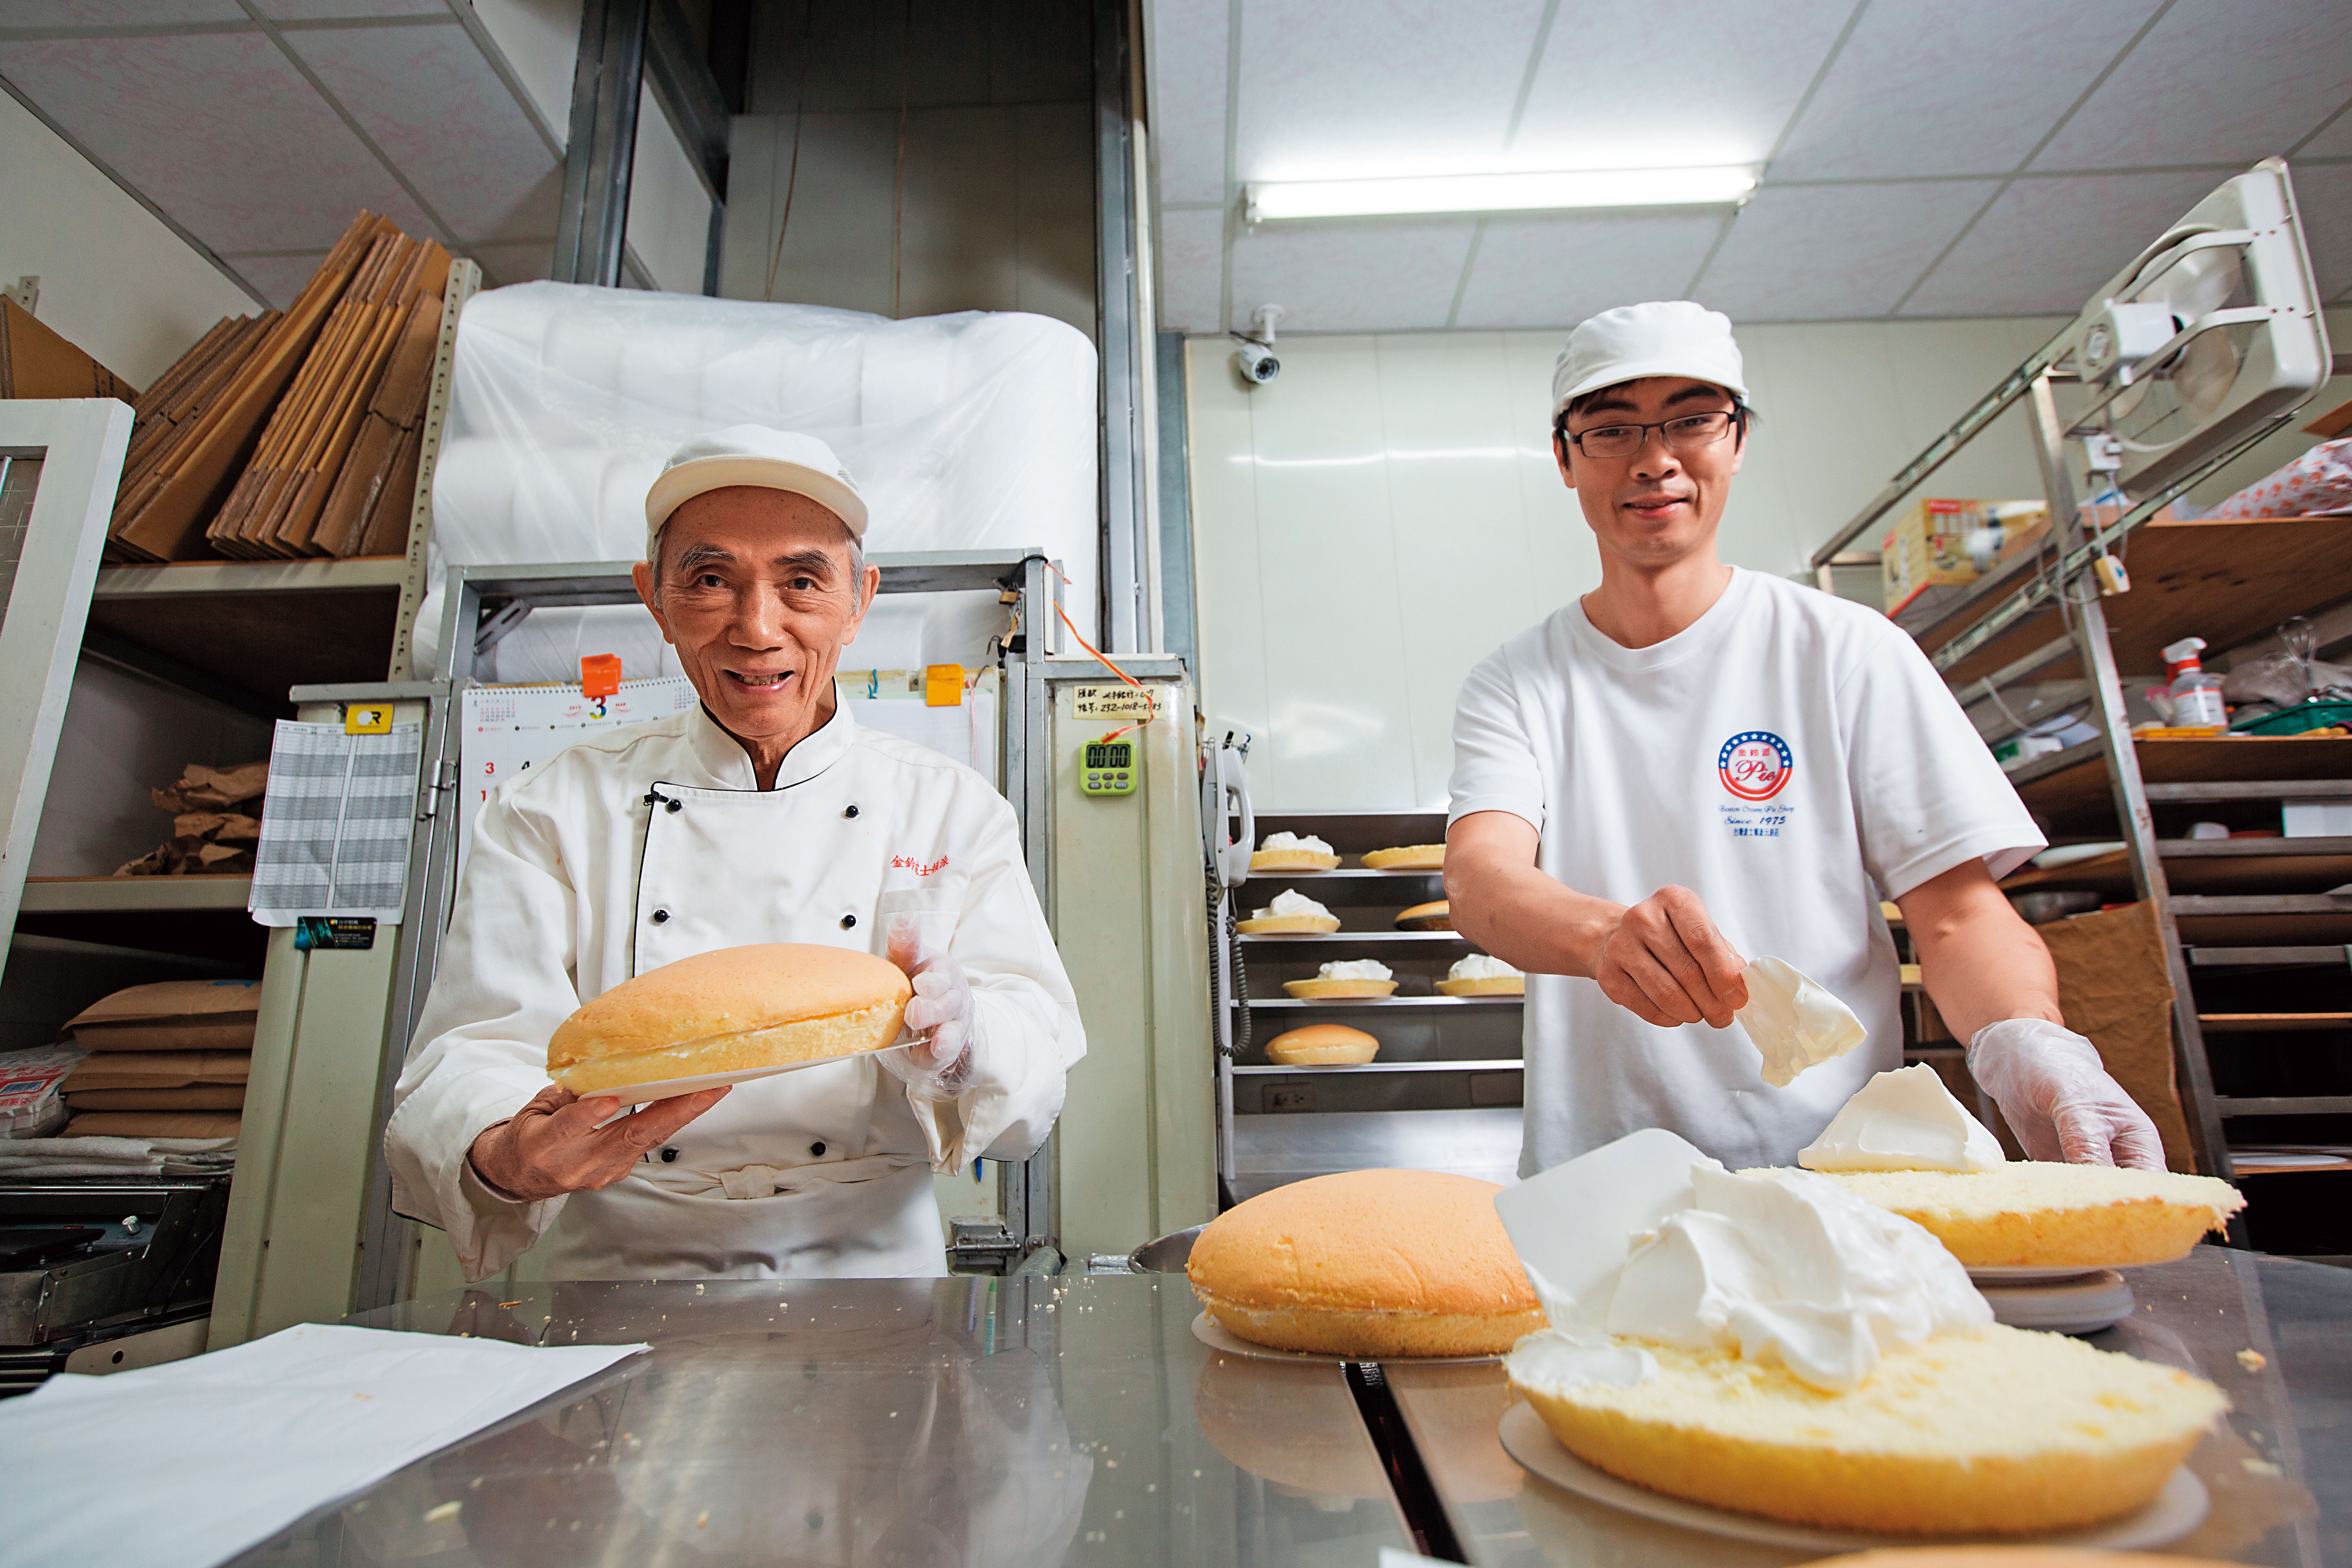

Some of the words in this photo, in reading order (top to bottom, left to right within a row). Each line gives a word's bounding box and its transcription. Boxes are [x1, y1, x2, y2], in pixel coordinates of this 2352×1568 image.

[589, 695, 607, 719] 3
[1100, 702, 1161, 712] 232-1018-583
[485, 762, 494, 774] 3
[521, 760, 530, 770] 4
[1735, 759, 1776, 781] Pie
[1724, 815, 1752, 824] Since
[1759, 816, 1786, 825] 1975
